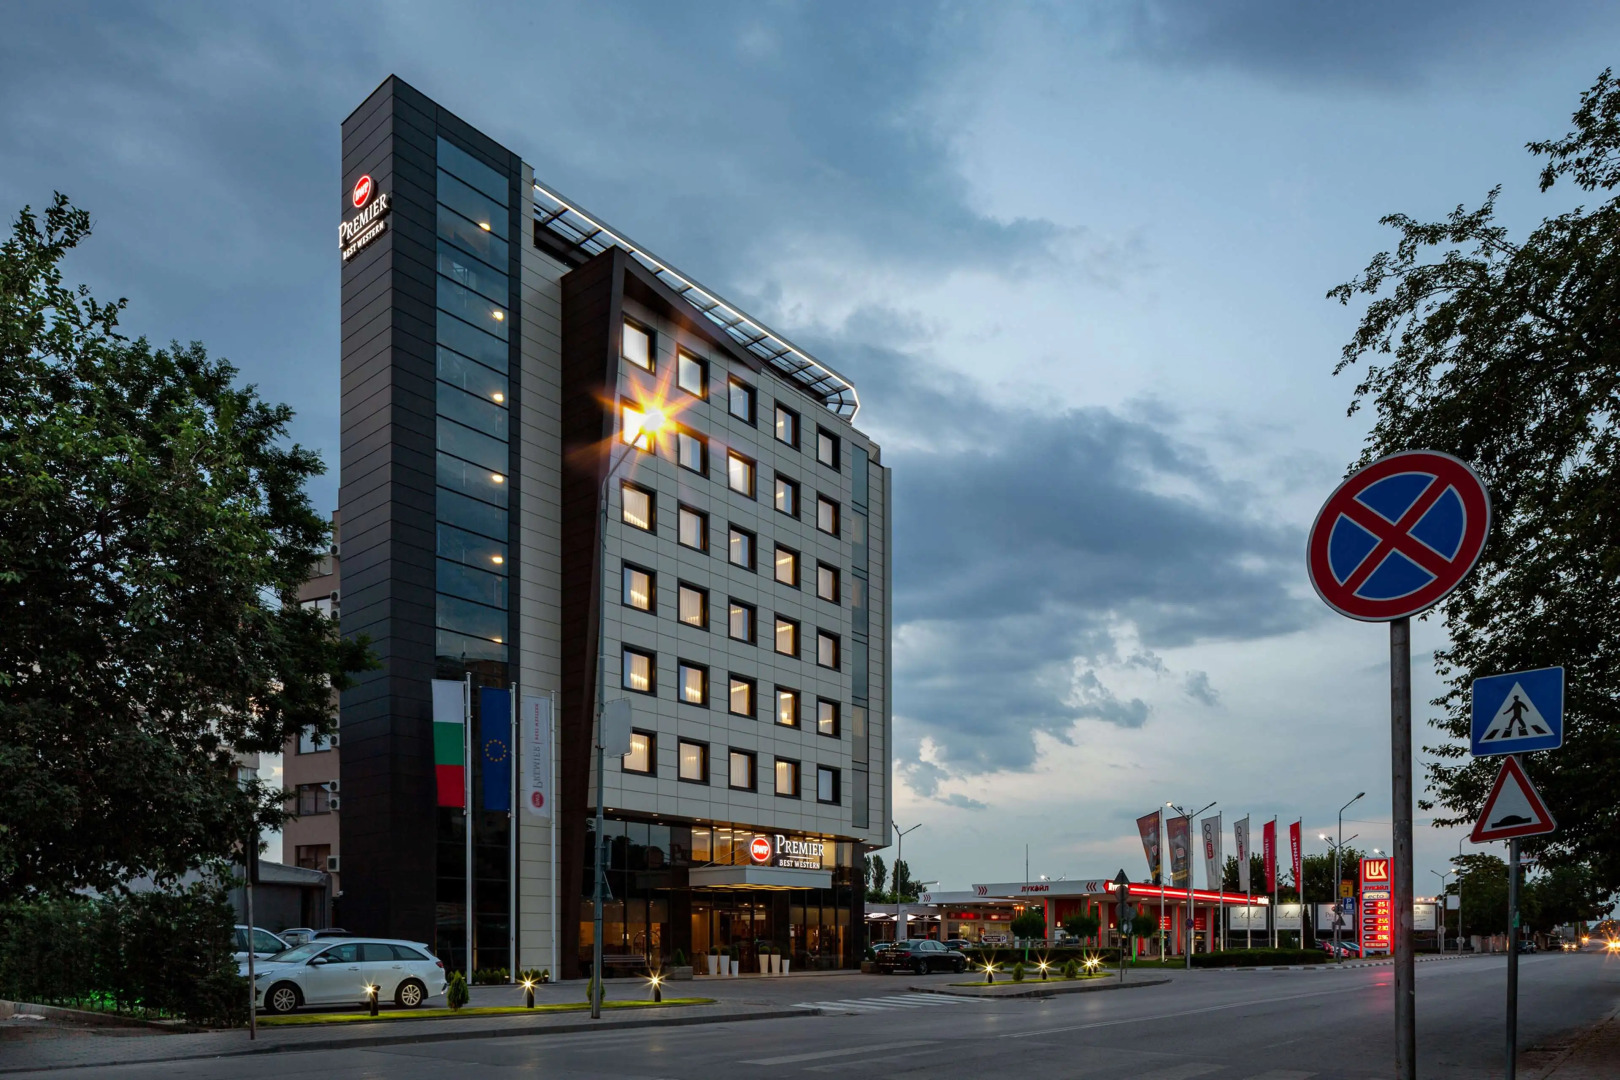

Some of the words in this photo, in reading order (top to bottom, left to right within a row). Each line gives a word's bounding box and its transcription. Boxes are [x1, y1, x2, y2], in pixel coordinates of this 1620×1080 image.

[338, 193, 388, 249] PREMIER
[343, 243, 357, 260] BEST
[357, 220, 385, 249] WESTERN
[753, 844, 769, 854] BWP
[775, 834, 825, 856] PREMIER
[779, 859, 793, 867] BEST
[794, 861, 821, 869] WESTERN
